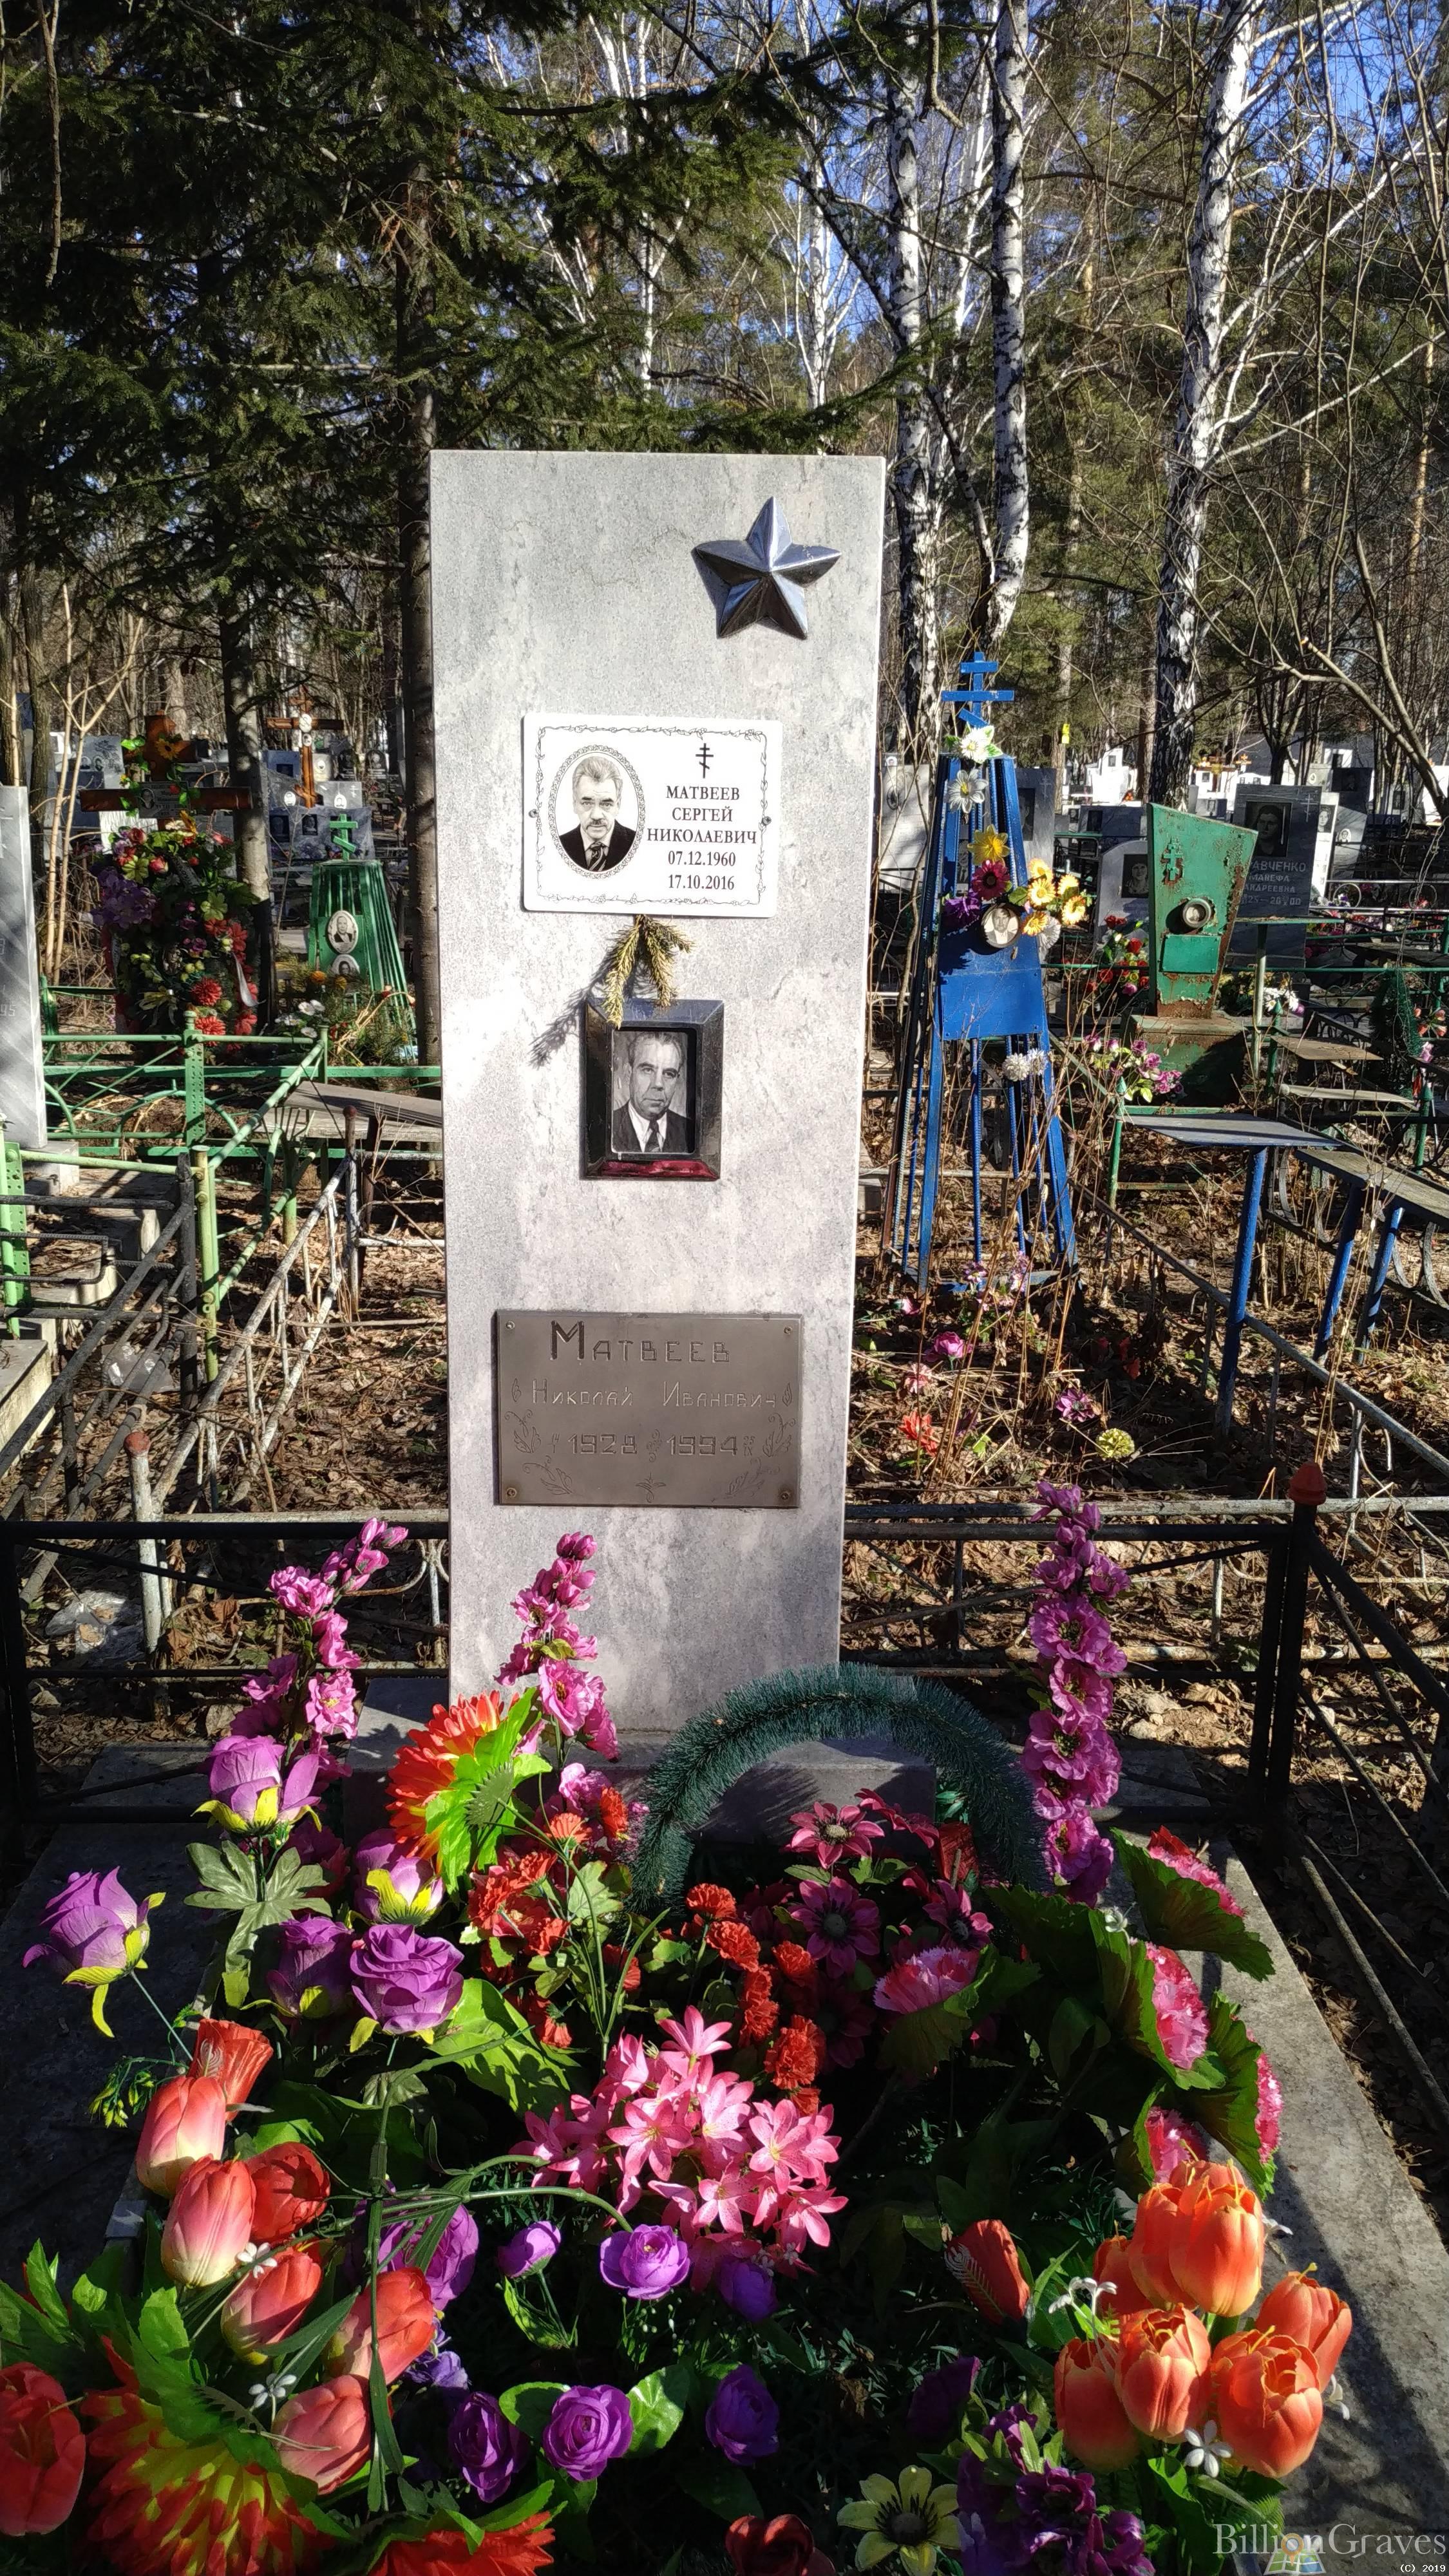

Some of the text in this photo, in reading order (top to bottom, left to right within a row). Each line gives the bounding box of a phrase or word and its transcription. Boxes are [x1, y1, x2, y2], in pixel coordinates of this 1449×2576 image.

[666, 786, 740, 800] МАТВЕЕВ
[672, 806, 733, 822] СЕРГЕЙ
[647, 828, 757, 844] НИКОЛАЕВИЧ
[668, 850, 735, 866] 07.12.1960
[1251, 860, 1307, 872] АВЧЕНКО
[668, 874, 735, 890] 17.10.2016
[567, 1434, 638, 1454] 1928
[667, 1435, 738, 1456] 1994
